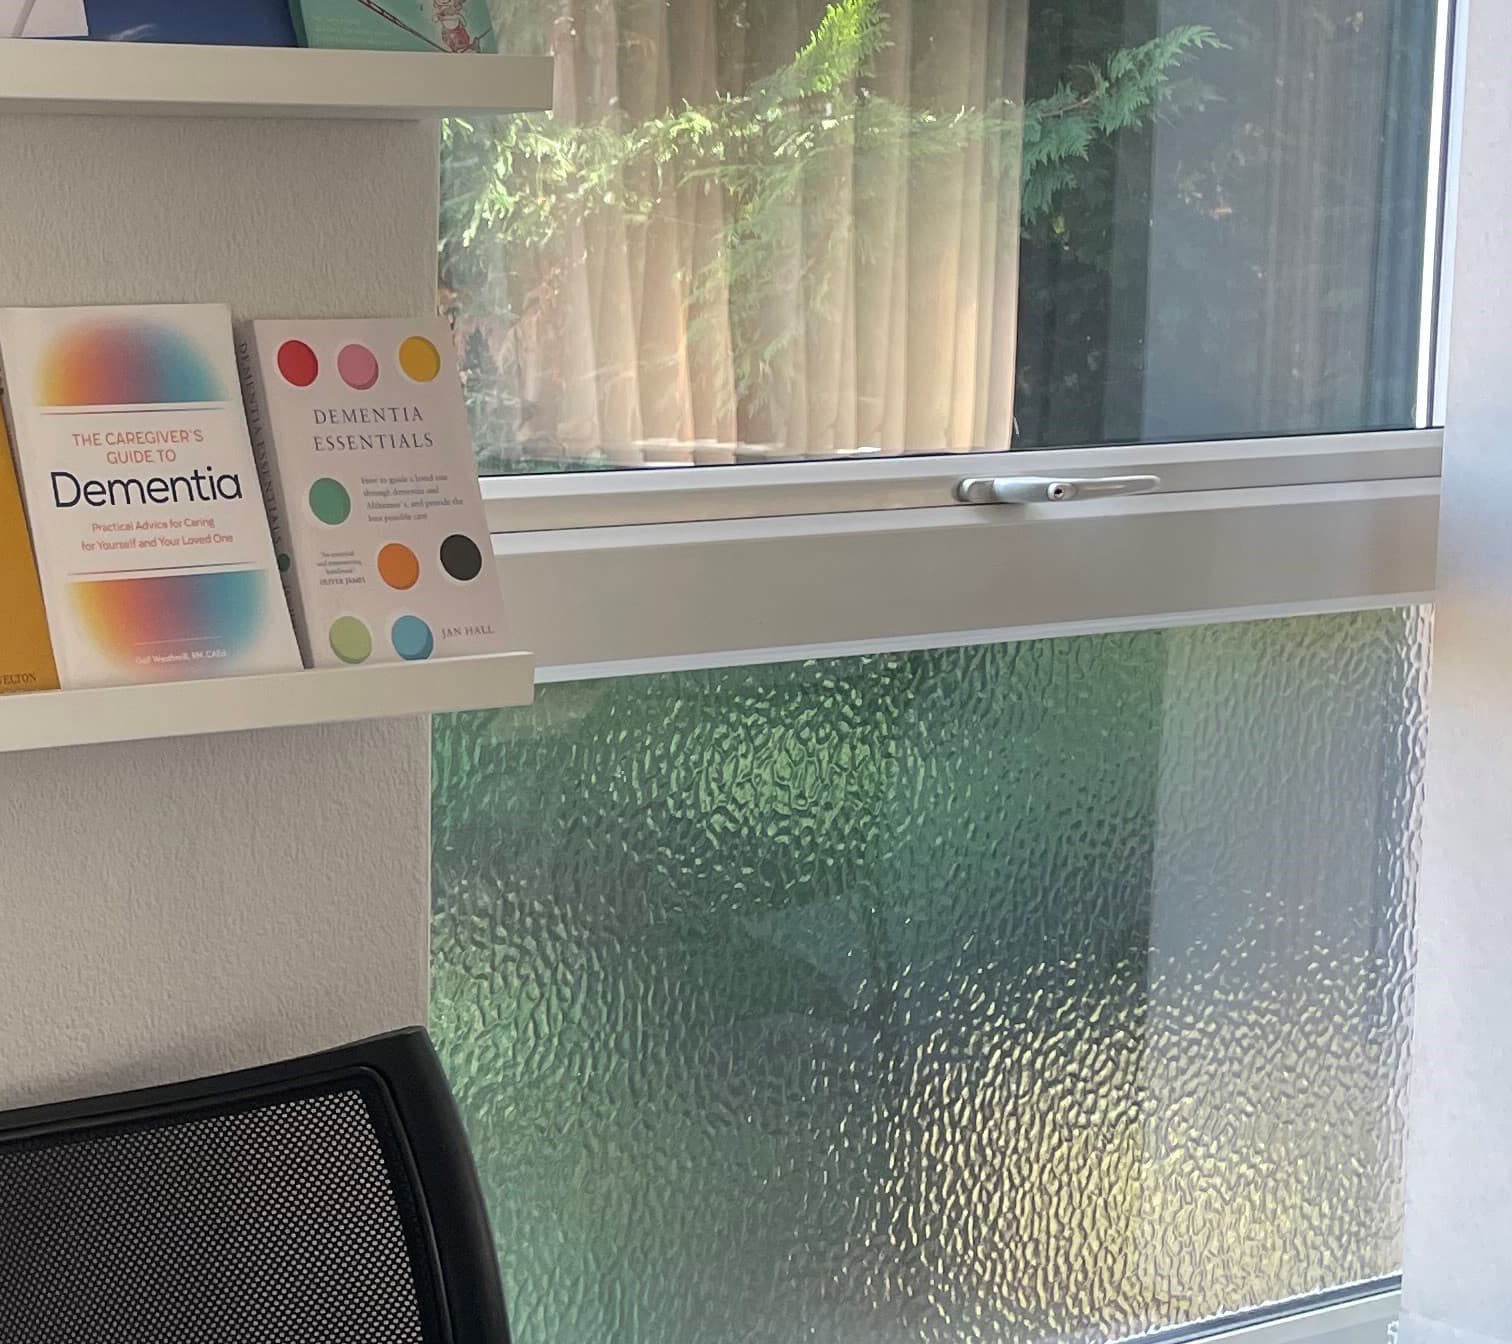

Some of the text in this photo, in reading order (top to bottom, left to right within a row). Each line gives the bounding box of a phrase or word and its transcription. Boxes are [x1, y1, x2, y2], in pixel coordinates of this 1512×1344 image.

[314, 407, 424, 425] DEMENTIA
[72, 430, 204, 446] THE CAREGIVER'S
[314, 433, 434, 451] ESSENTIALS
[107, 449, 177, 465] GUIDE TO
[50, 466, 243, 508] Dementia
[441, 624, 495, 639] JAN HALL
